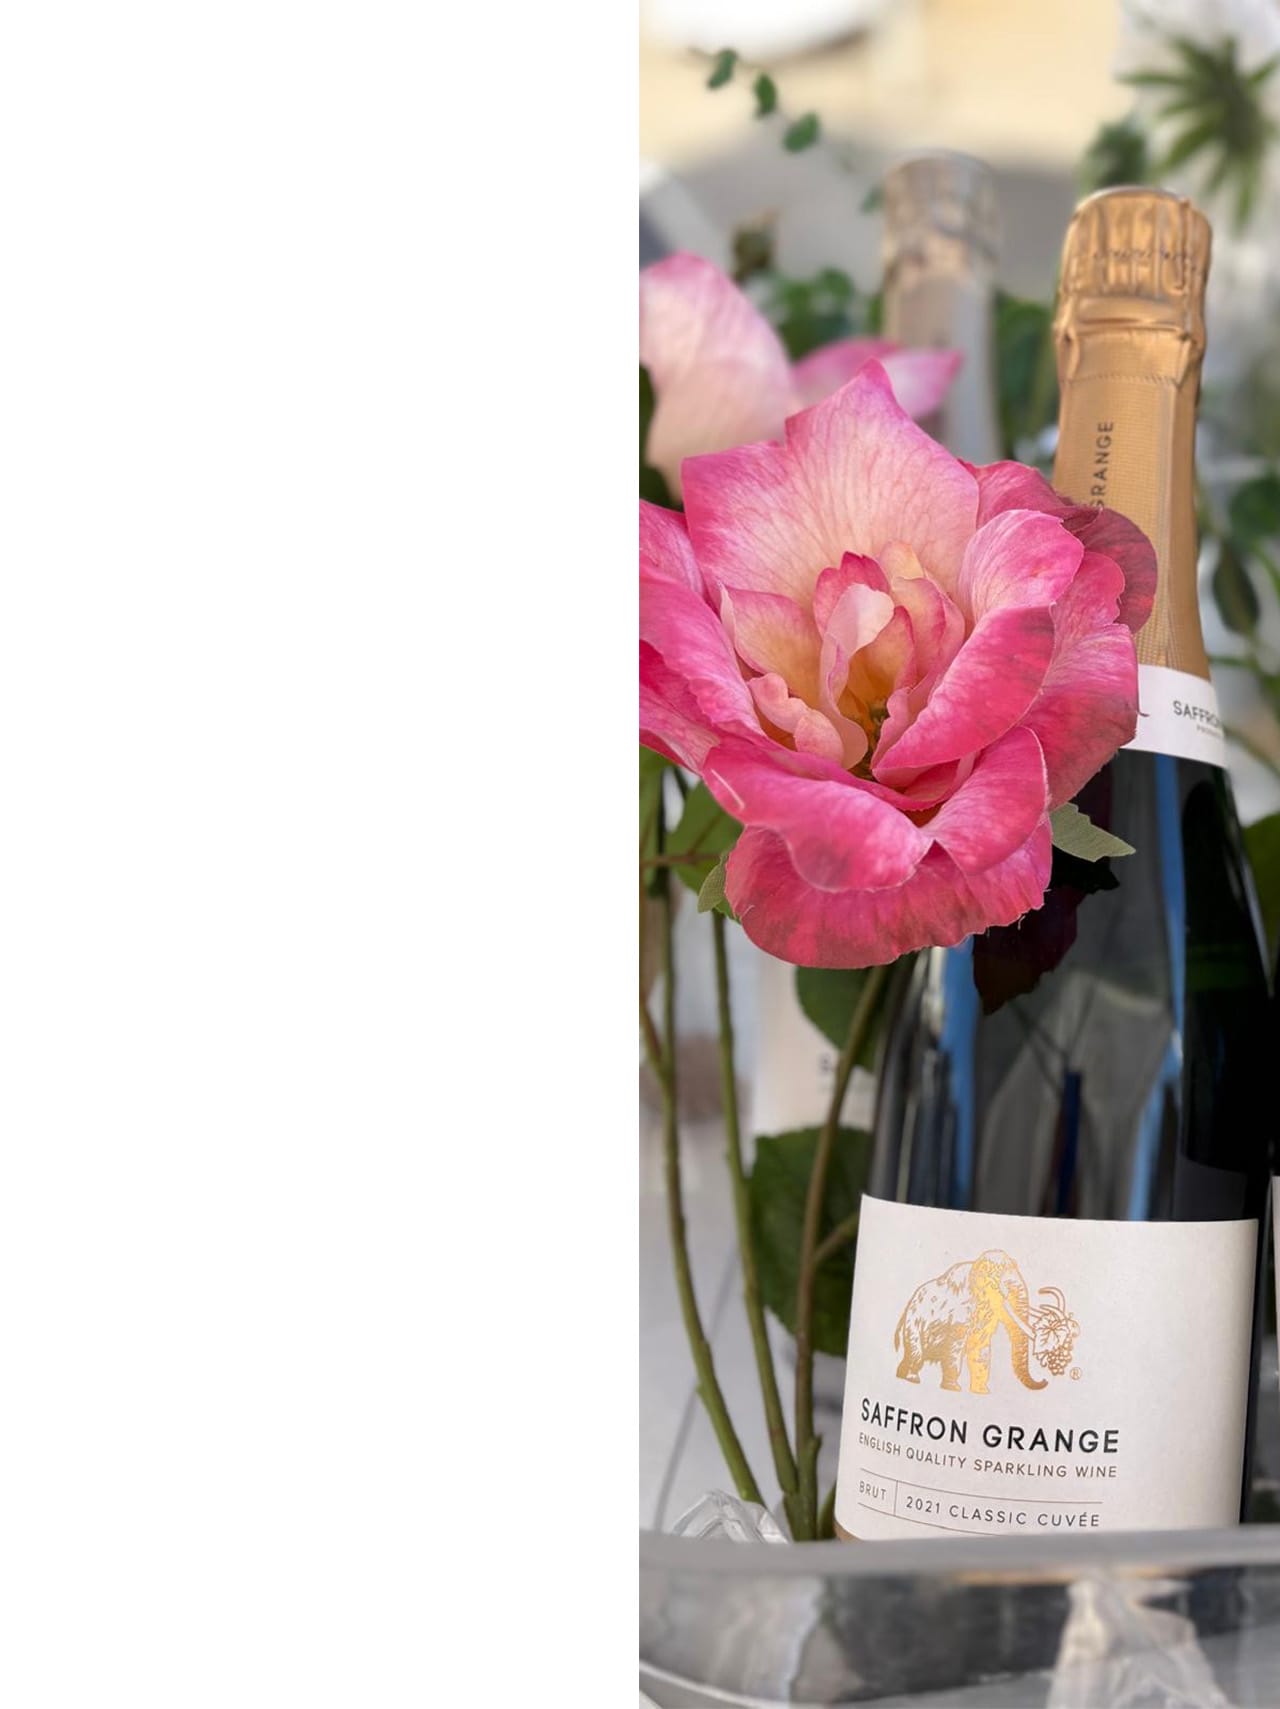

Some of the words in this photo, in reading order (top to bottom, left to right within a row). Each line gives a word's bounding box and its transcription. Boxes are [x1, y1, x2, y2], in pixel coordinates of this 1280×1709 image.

[1172, 700, 1222, 729] SAFFRO
[860, 1397, 968, 1445] SAFFRON
[982, 1424, 1120, 1454] GRANGE
[858, 1431, 902, 1457] ENGLISH
[905, 1446, 967, 1470] QUALITY
[972, 1458, 1068, 1478] SPARKLING
[1074, 1465, 1118, 1479] WINE
[858, 1480, 887, 1501] BRUT
[905, 1495, 941, 1515] 2021
[948, 1504, 1028, 1526] CLASSIC
[1037, 1510, 1101, 1528] CUVÉE
